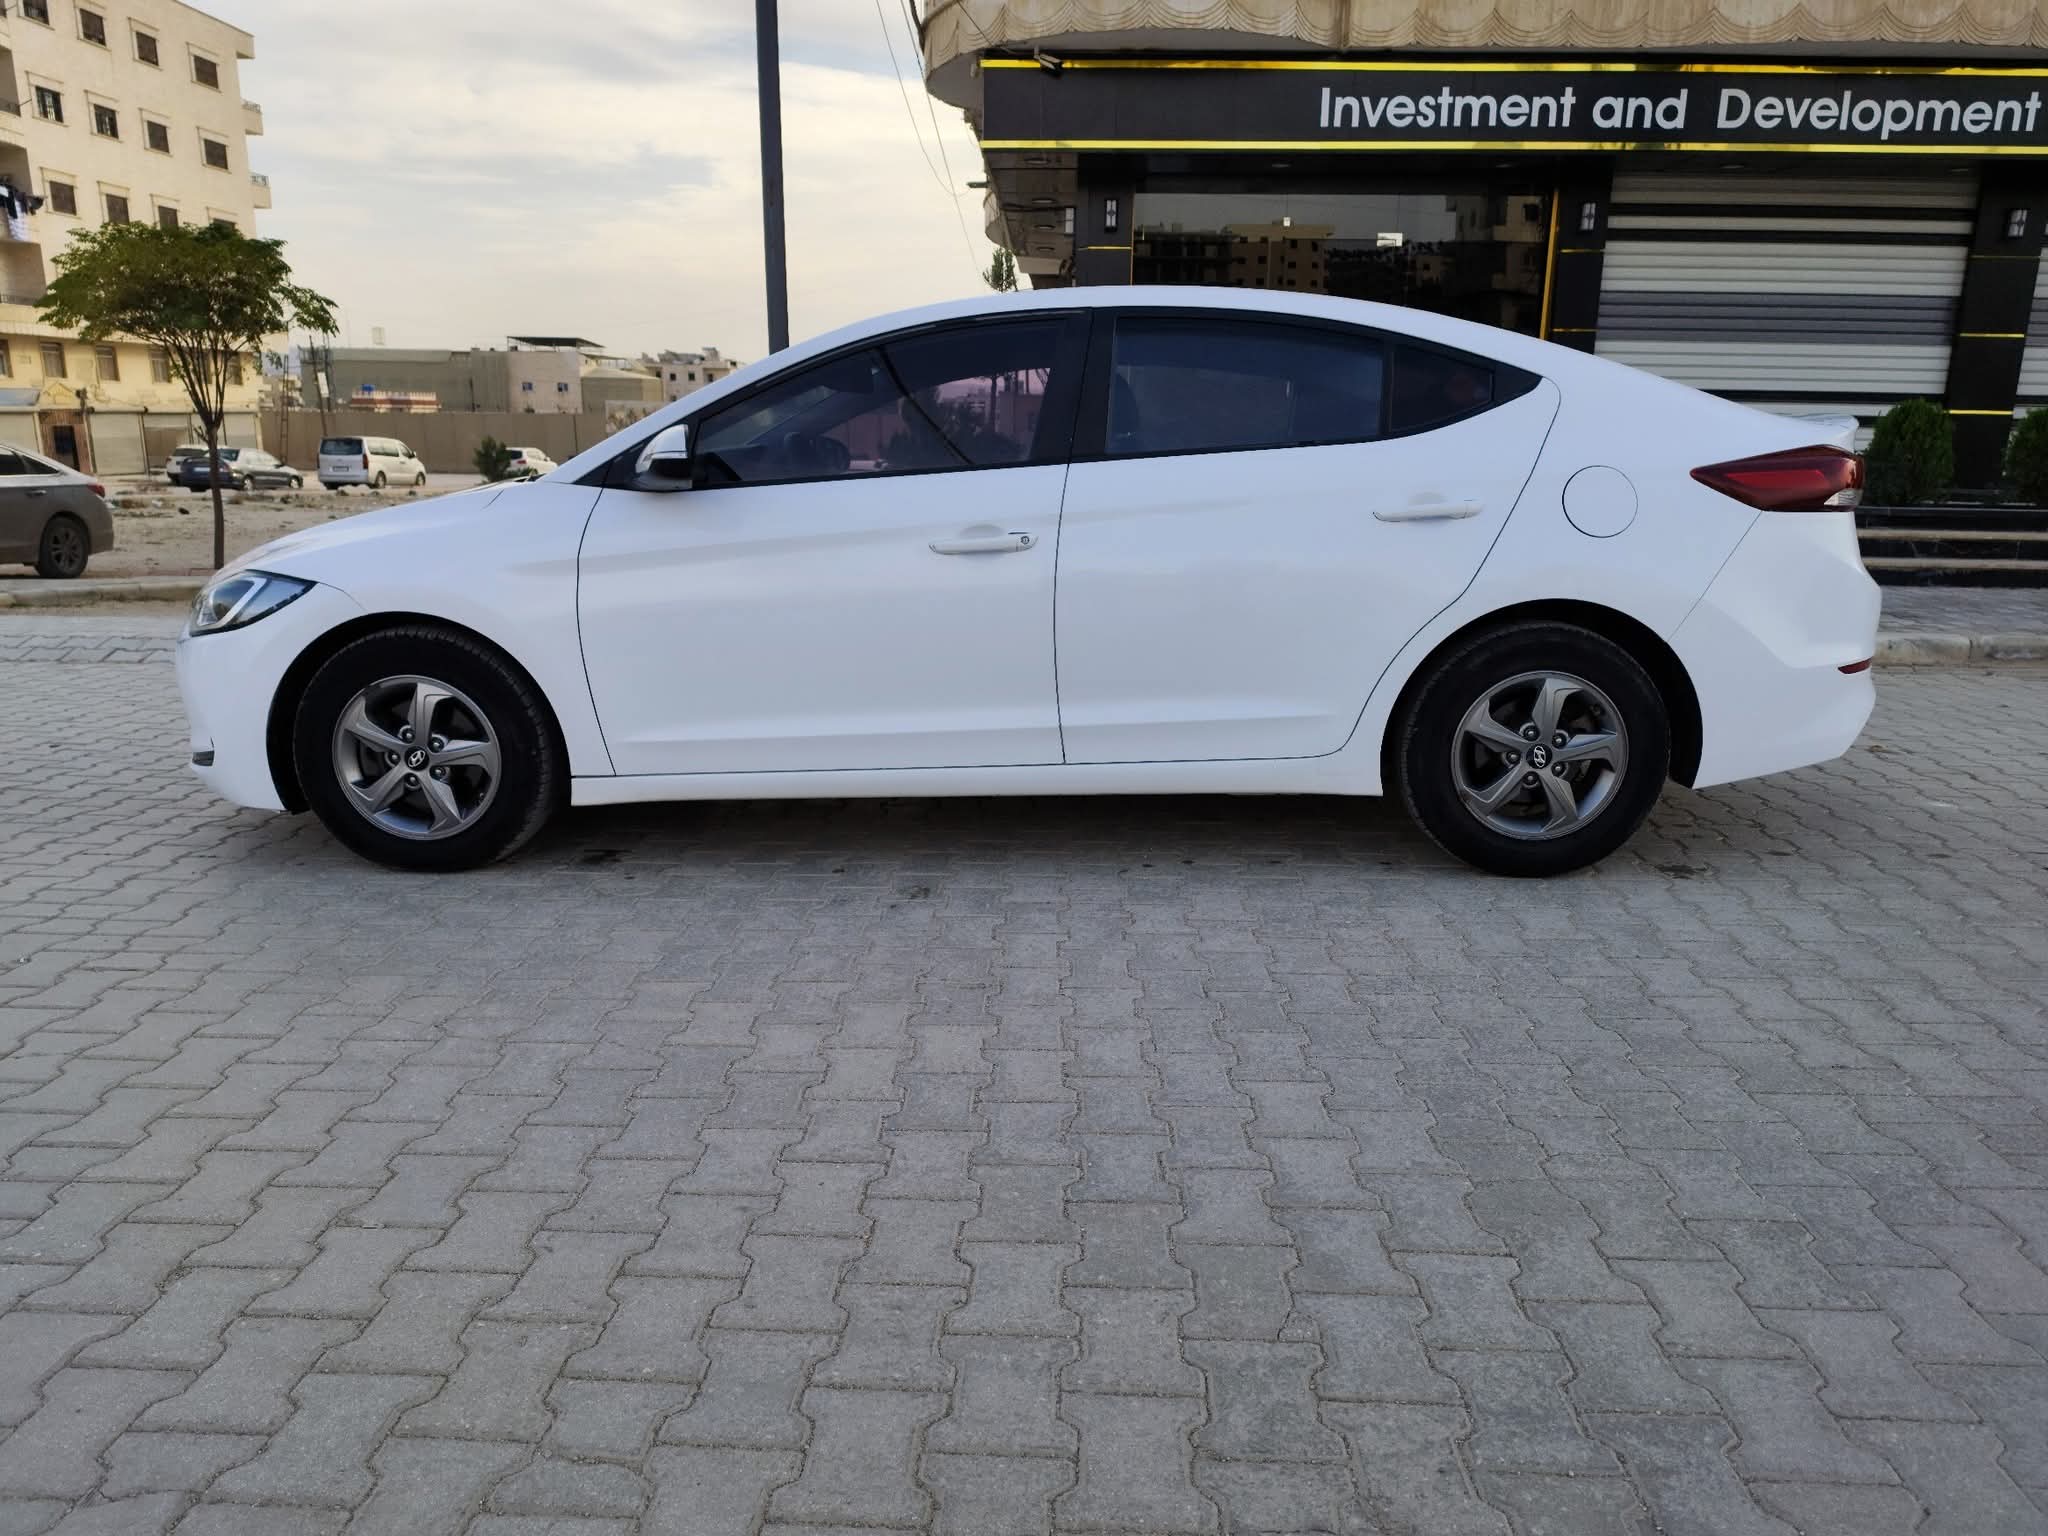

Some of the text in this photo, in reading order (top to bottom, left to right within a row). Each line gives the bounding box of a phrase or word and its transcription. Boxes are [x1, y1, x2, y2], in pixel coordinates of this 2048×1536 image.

[1319, 86, 2042, 141] Investment and Development
